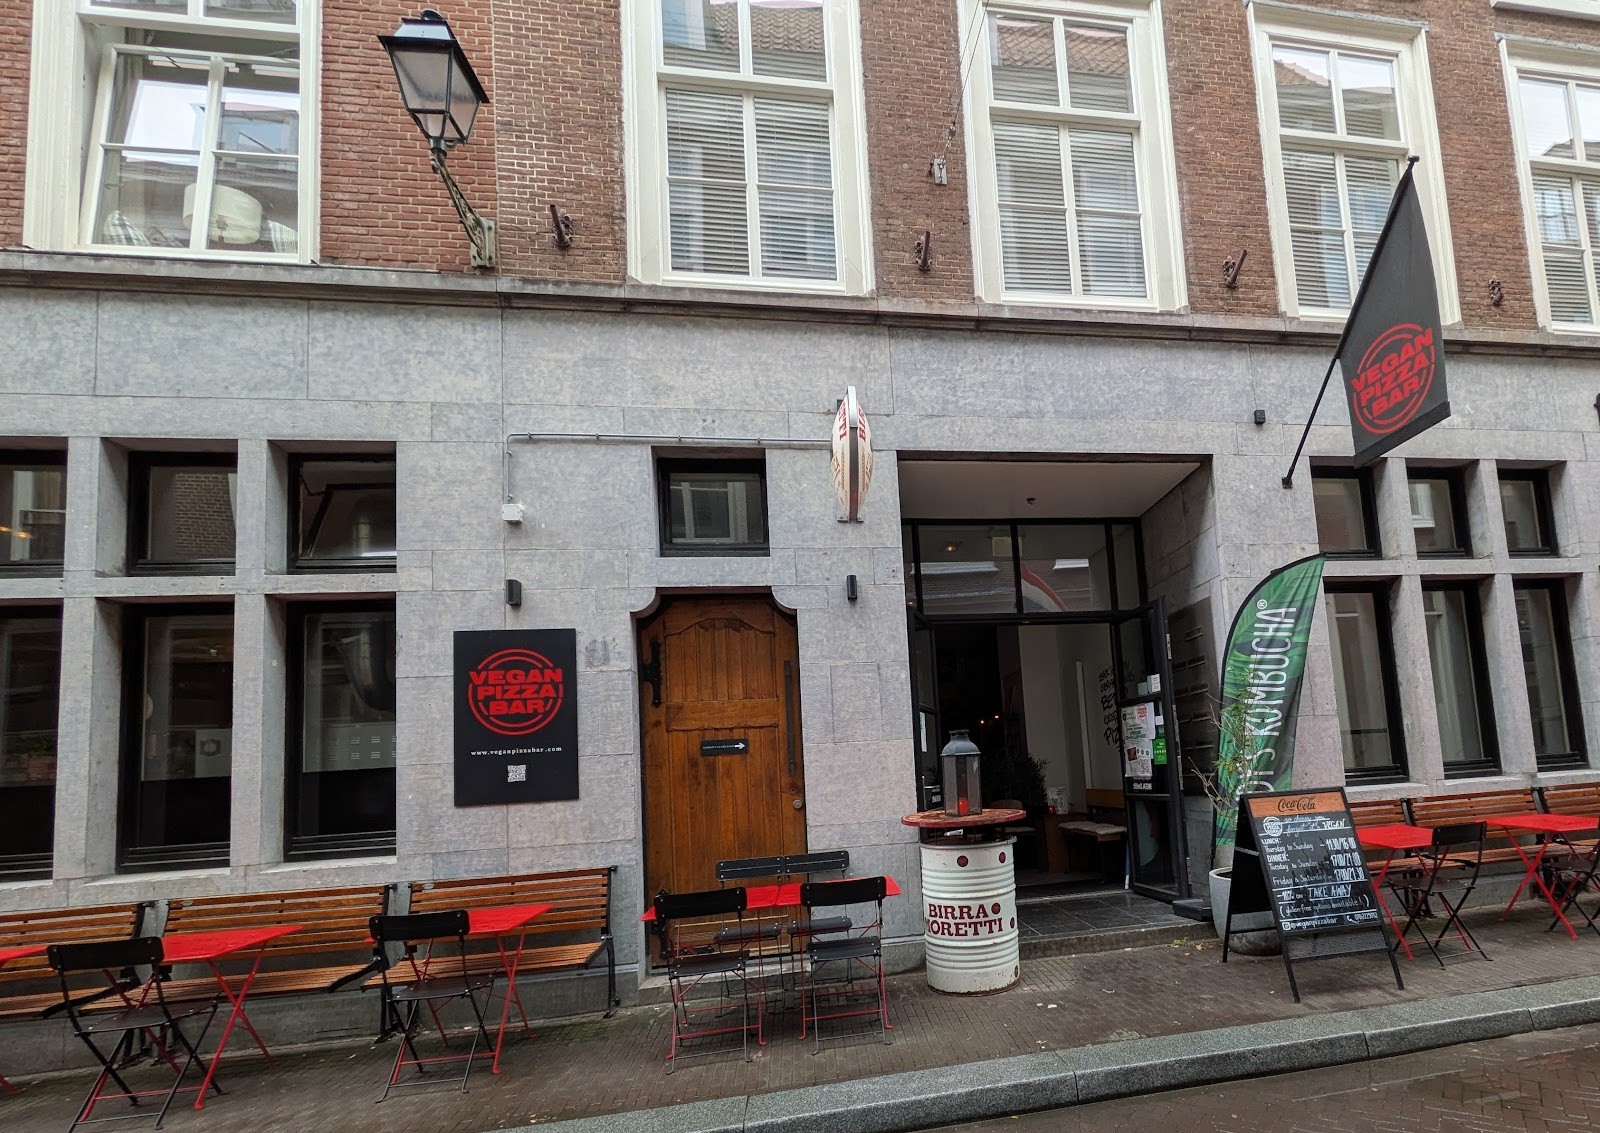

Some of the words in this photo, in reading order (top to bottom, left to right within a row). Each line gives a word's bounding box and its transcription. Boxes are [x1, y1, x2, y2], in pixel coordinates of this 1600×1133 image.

[1351, 327, 1433, 392] VEGAN
[1359, 353, 1429, 407] PIZZA
[1372, 375, 1420, 417] BAR
[469, 668, 563, 685] VEGAN
[477, 684, 557, 701] PIZZA
[489, 699, 545, 715] BAR
[470, 746, 562, 756] www.veganpizzabar.com
[1277, 796, 1316, 812] Coca-Cola
[1322, 819, 1346, 830] VEGAN
[1293, 842, 1314, 851] Sunday
[1267, 854, 1290, 862] DINNER:
[1269, 863, 1289, 872] Tuesday
[1298, 859, 1319, 868] Sunday
[1272, 876, 1293, 886] Friday
[1307, 886, 1329, 898] TAKE
[1331, 884, 1351, 897] AWAY
[928, 904, 989, 919] BIRRA
